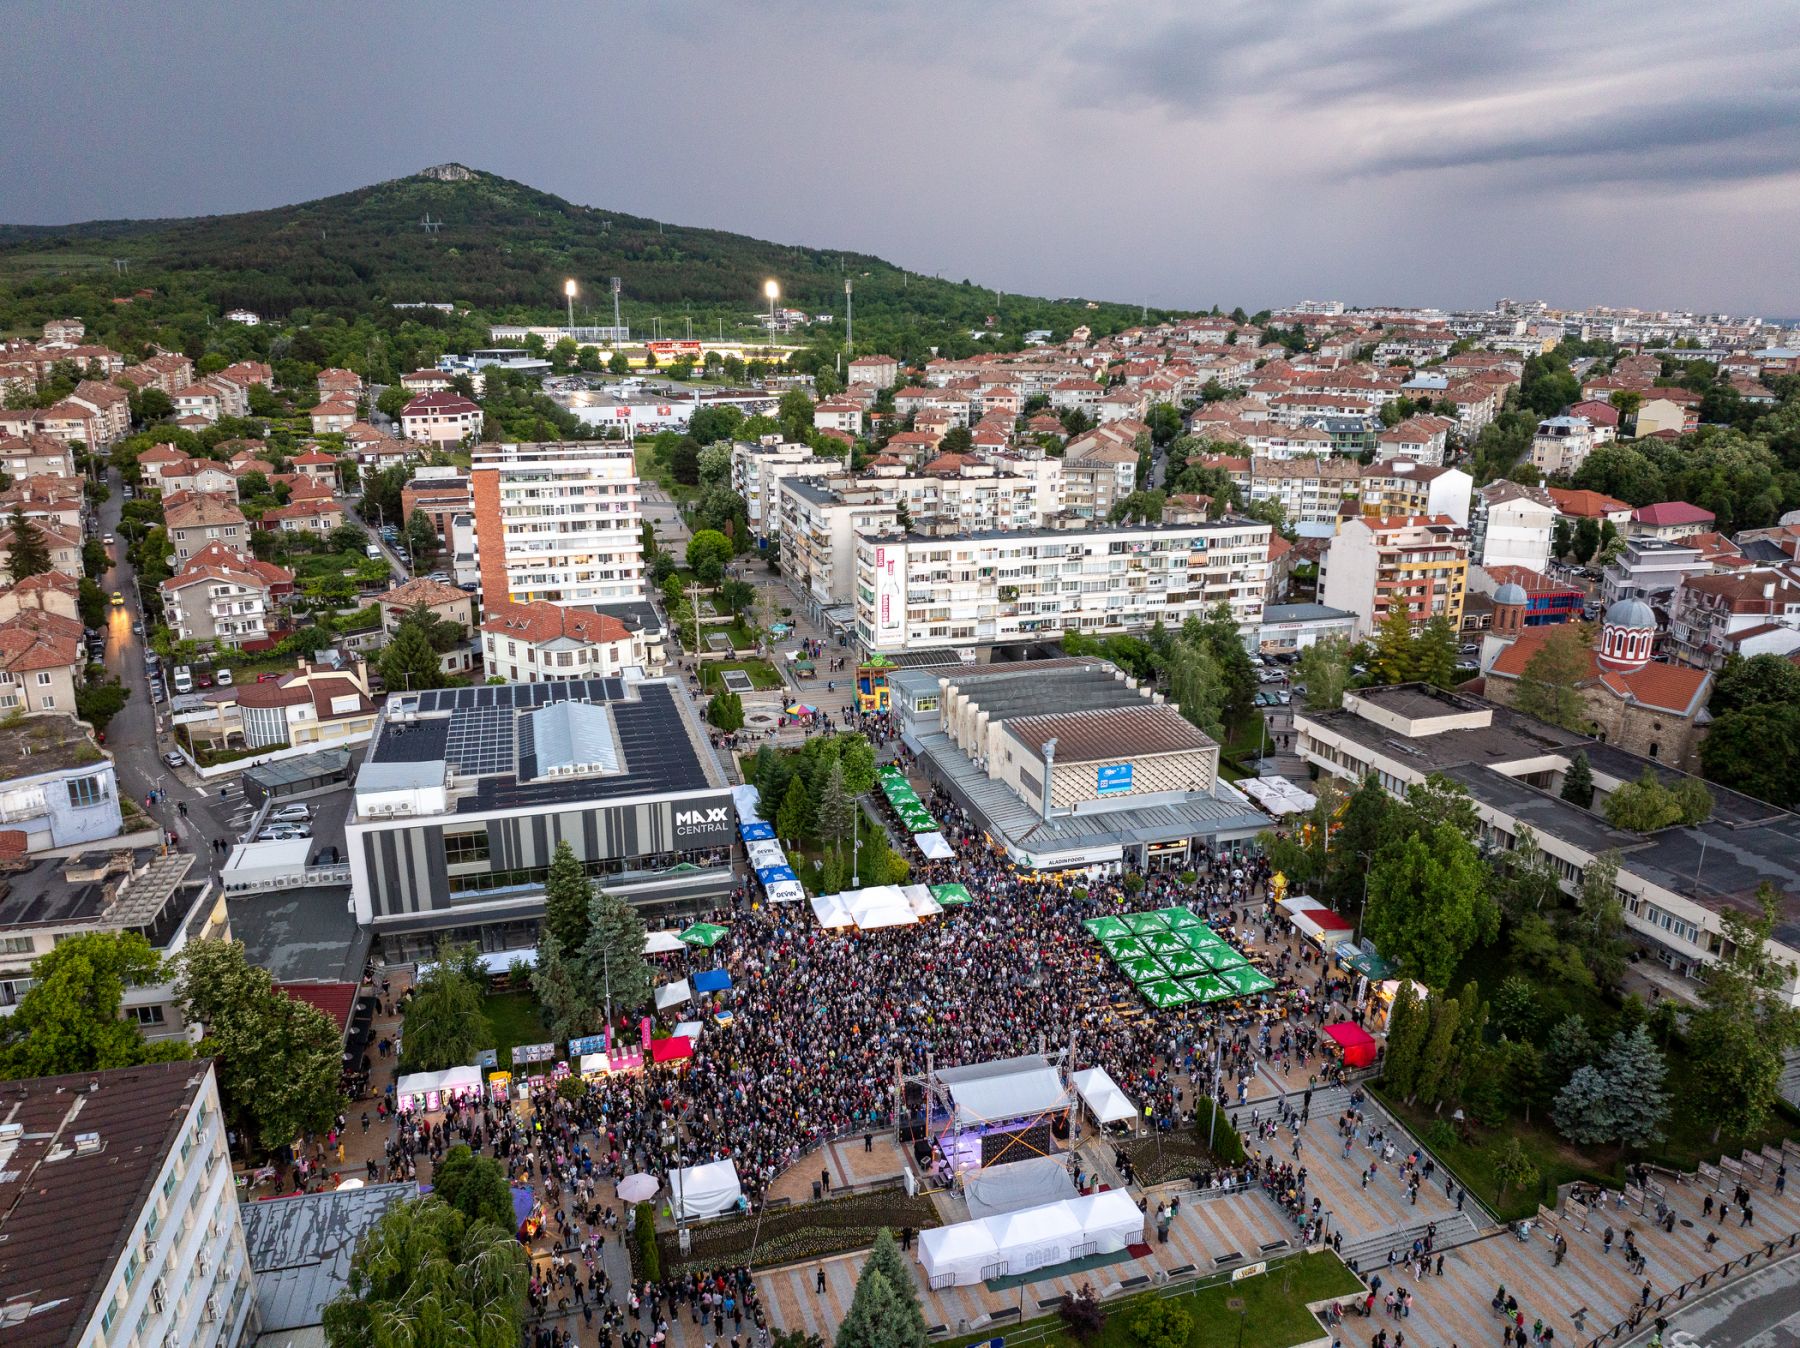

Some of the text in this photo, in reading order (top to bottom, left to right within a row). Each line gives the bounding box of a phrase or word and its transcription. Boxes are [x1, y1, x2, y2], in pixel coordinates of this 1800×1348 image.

[676, 807, 728, 826] MAXX
[677, 823, 729, 836] CENTRAL
[776, 890, 797, 898] DEVIN
